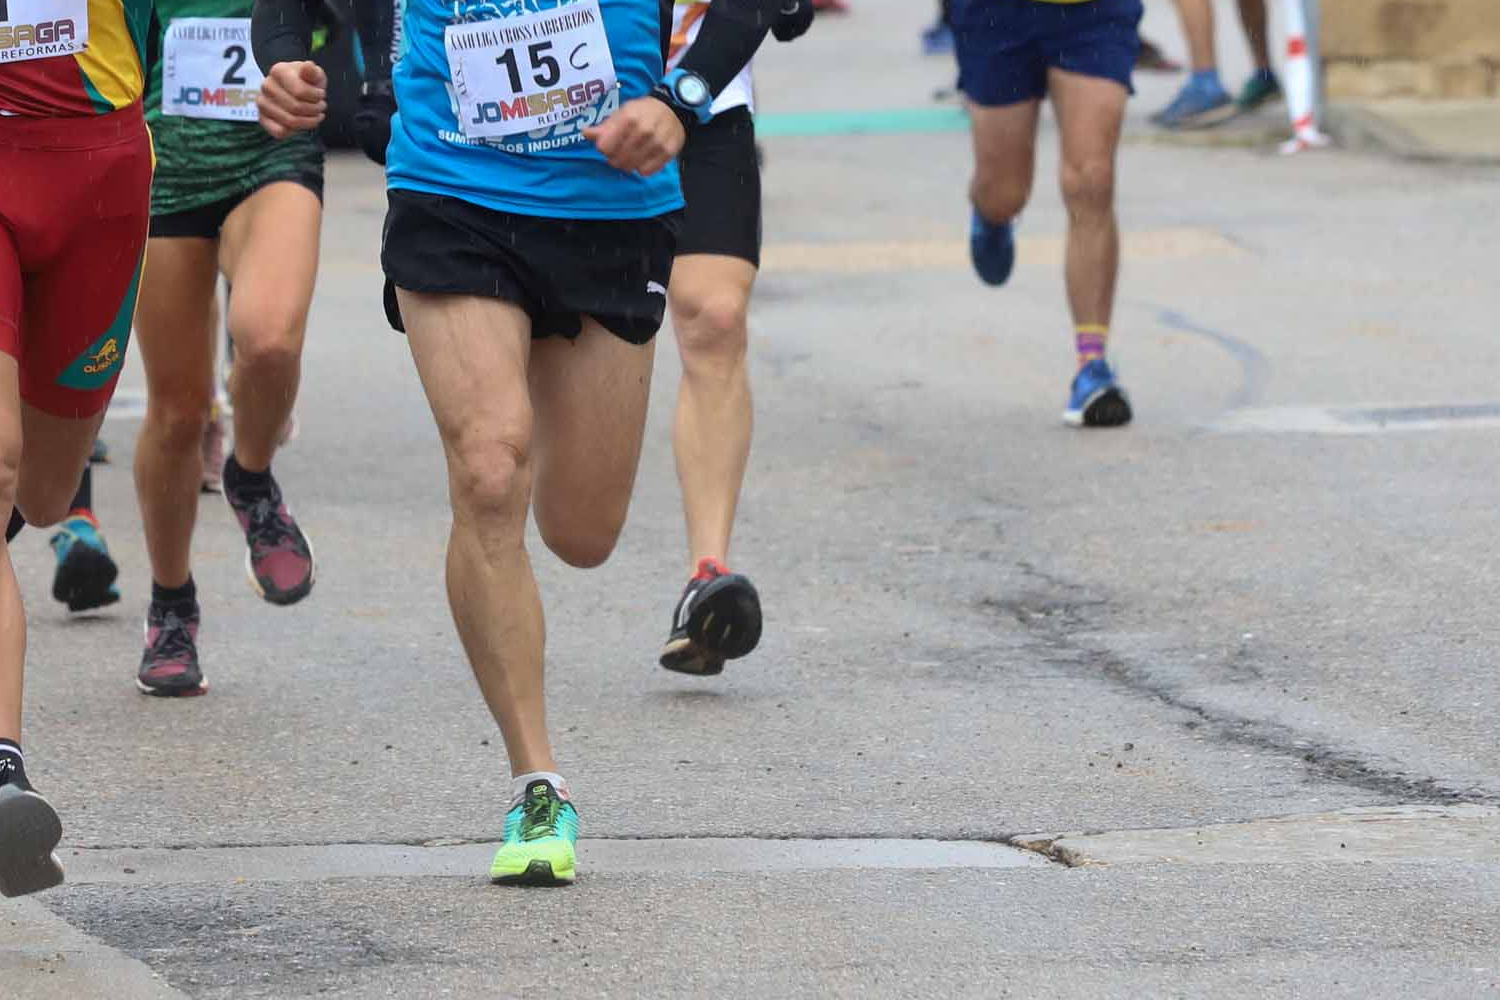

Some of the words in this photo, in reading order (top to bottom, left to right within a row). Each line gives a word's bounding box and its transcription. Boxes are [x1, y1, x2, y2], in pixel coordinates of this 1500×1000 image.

[499, 25, 532, 46] CROSS
[532, 8, 596, 37] CABRERIZOS
[1, 41, 75, 60] REFORMAS
[222, 45, 247, 85] 2
[495, 40, 561, 94] 15
[472, 79, 605, 124] JOMISAGA
